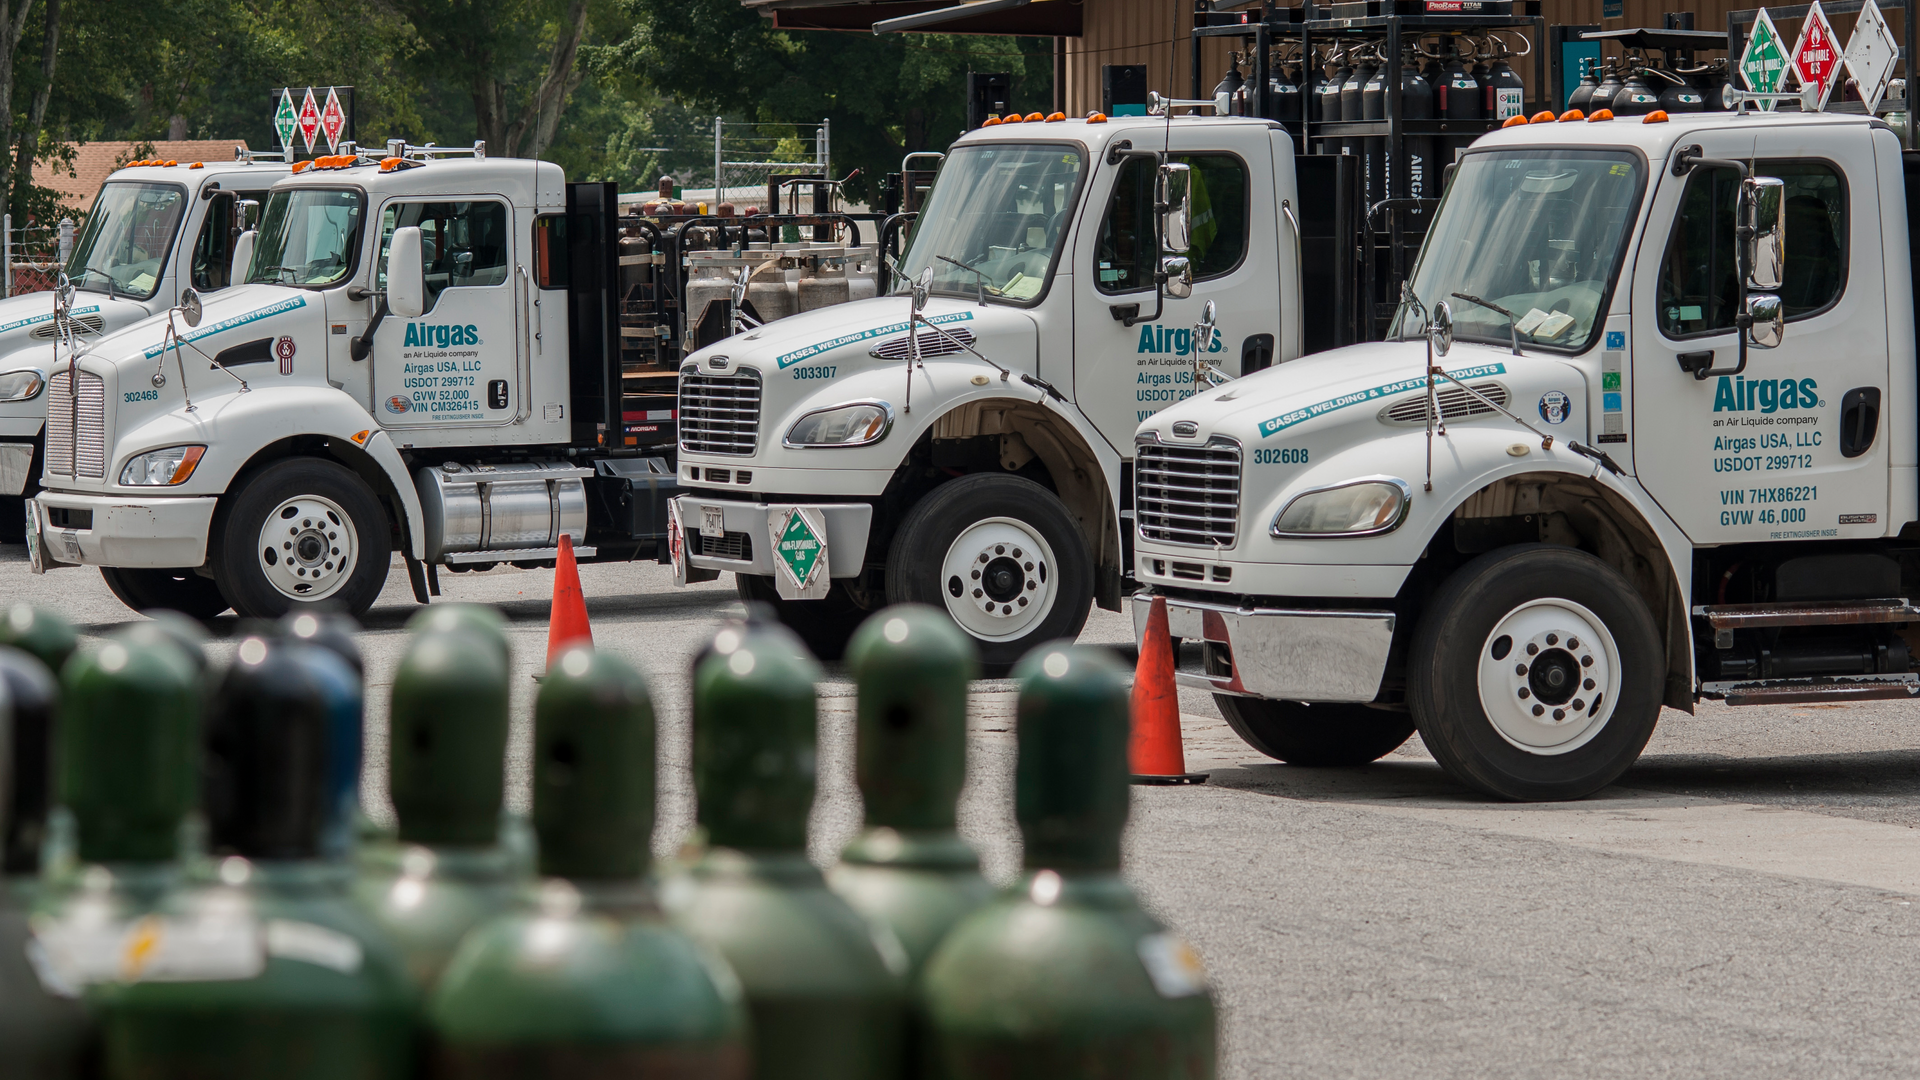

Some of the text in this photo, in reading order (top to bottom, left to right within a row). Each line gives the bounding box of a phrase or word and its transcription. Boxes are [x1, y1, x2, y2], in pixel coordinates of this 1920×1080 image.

[1810, 62, 1821, 75] GS
[1759, 70, 1770, 83] GS
[224, 312, 256, 327] SAFETY
[255, 298, 301, 318] PRODUCTS
[0, 321, 21, 331] LDING
[403, 322, 479, 348] Airgas
[423, 350, 447, 359] Liquide
[448, 350, 478, 358] company
[781, 348, 819, 365] GASES,
[817, 333, 863, 350] WELDING
[403, 361, 481, 375] Airgas USA, LLC
[1160, 358, 1187, 367] Liquide
[793, 365, 837, 380] 303307
[1137, 371, 1171, 387] Airgas
[404, 376, 474, 388] USDOT 299712
[124, 390, 158, 403] 302468
[413, 390, 469, 402] GVW 52,000
[1137, 389, 1176, 401] USDOT
[1713, 375, 1819, 413] Airgas
[411, 402, 428, 412] VIN
[431, 401, 478, 412] CM326415
[1265, 409, 1312, 432] GASES,
[1309, 391, 1367, 414] WELDING
[1369, 389, 1378, 397] &
[1382, 377, 1428, 394] SAFETY
[1726, 418, 1739, 426] Air
[1741, 416, 1774, 427] Liquide
[1776, 416, 1818, 426] company
[1714, 431, 1822, 453] Airgas USA, LLC
[1254, 448, 1309, 464] 302608
[1714, 454, 1812, 472] USDOT 299712
[1720, 485, 1817, 505] VIN 7HX86221
[1720, 507, 1806, 526] GVW 46,000
[1770, 528, 1838, 539] FIRE EXTINGUISHER INSIDE
[799, 567, 805, 578] 2
